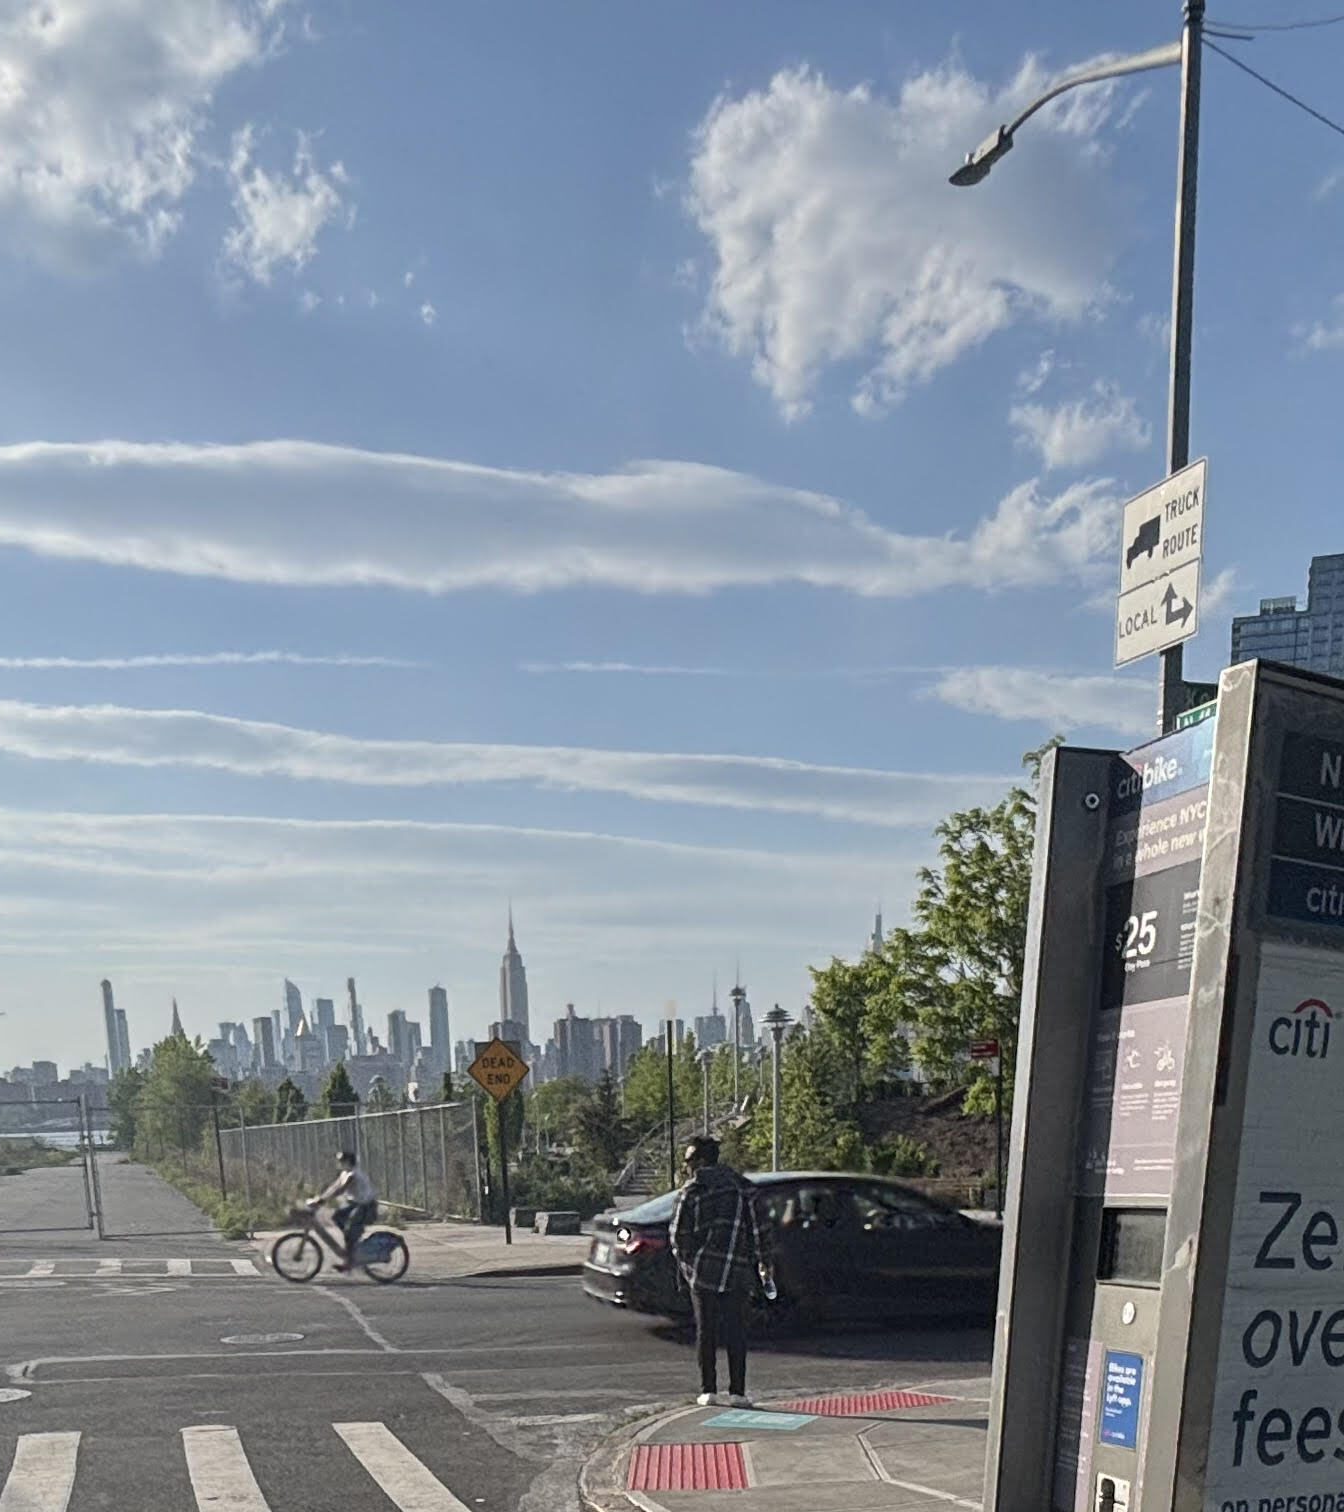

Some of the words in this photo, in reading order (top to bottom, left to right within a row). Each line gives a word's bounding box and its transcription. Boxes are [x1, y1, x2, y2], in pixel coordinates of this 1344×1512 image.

[1165, 486, 1200, 523] TRUCK
[1163, 523, 1199, 558] ROUTE
[1118, 605, 1158, 638] LOCAL
[1320, 752, 1342, 788] N
[1269, 1008, 1331, 1058] citi
[482, 1057, 514, 1069] DEAD
[487, 1073, 511, 1085] END
